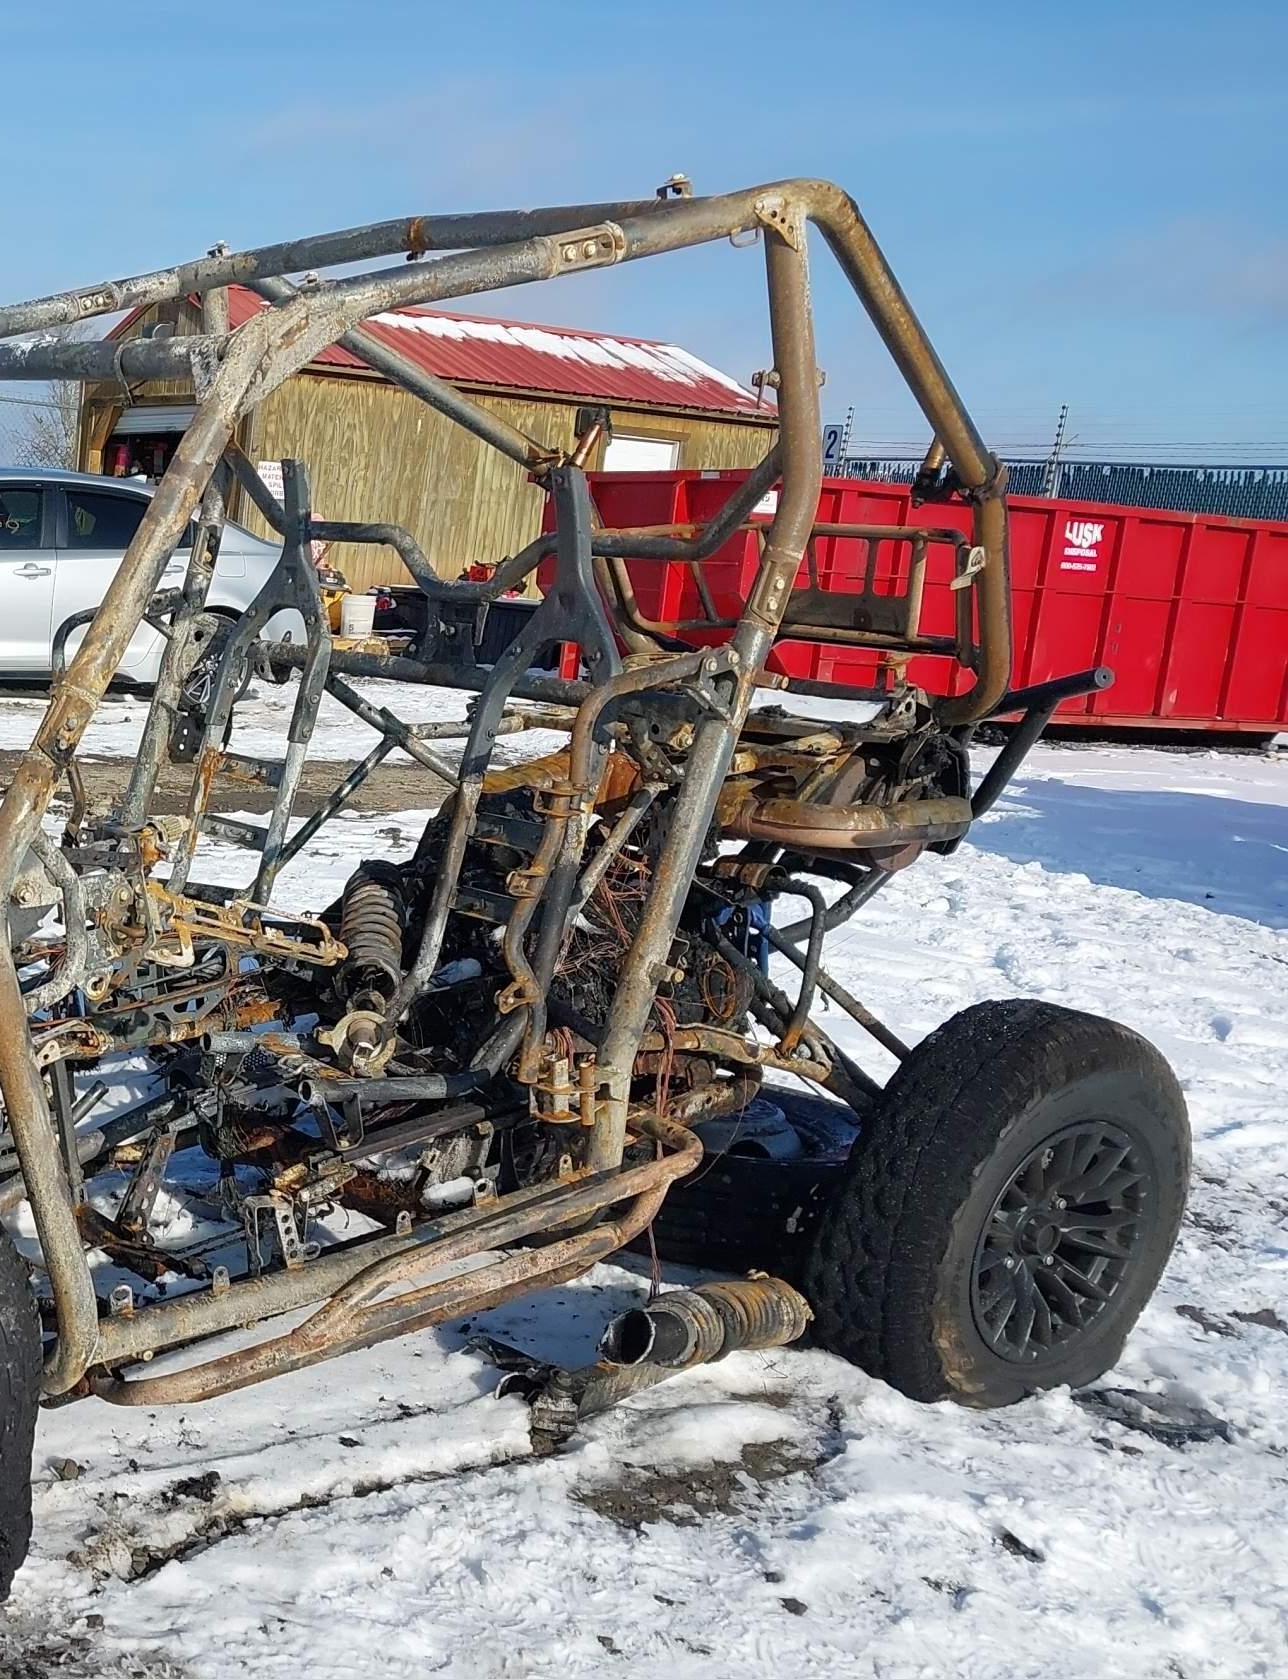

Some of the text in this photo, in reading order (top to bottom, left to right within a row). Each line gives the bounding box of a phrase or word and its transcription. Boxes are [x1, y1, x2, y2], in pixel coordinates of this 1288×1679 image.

[825, 430, 838, 459] 2
[258, 464, 282, 472] HAZAR
[1064, 521, 1104, 548] LUSK
